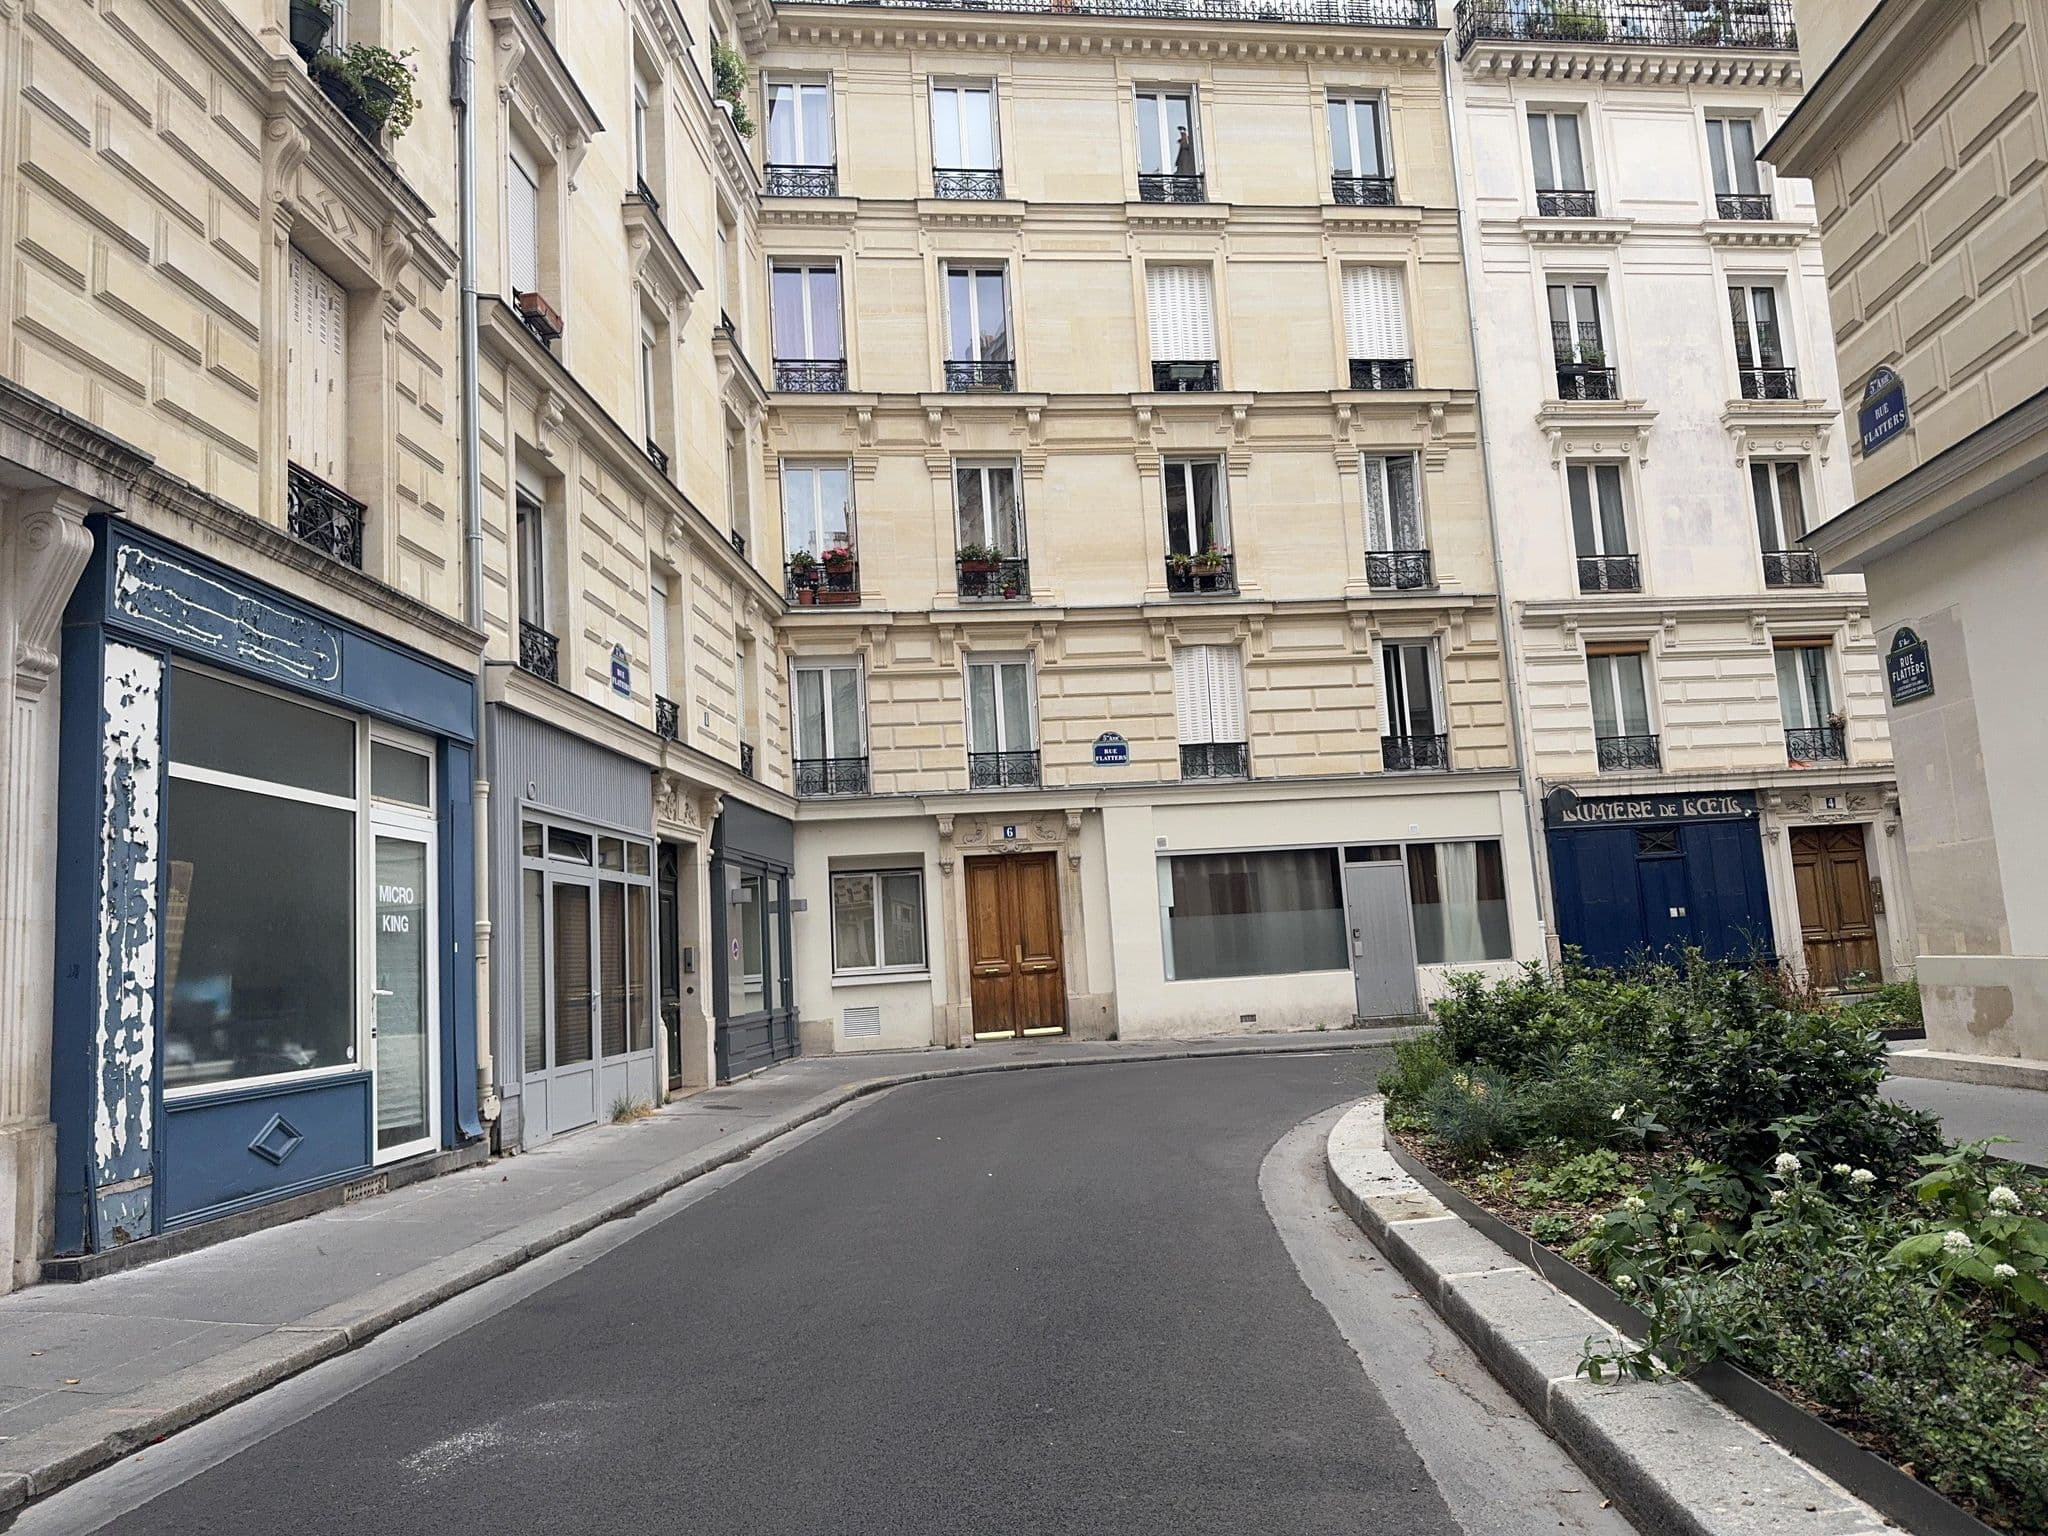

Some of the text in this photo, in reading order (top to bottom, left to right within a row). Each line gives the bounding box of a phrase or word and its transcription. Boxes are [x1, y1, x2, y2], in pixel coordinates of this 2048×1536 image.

[1874, 402, 1890, 420] RUE
[1863, 409, 1905, 445] FLATTERS
[1899, 653, 1914, 668] RUE
[1892, 661, 1925, 683] FLATTERS
[1095, 754, 1128, 762] FLATTERS
[1658, 804, 1679, 817] DE
[1828, 798, 1834, 809] 4
[1006, 826, 1014, 838] 6
[379, 884, 414, 904] MICRO
[382, 914, 409, 932] KING
